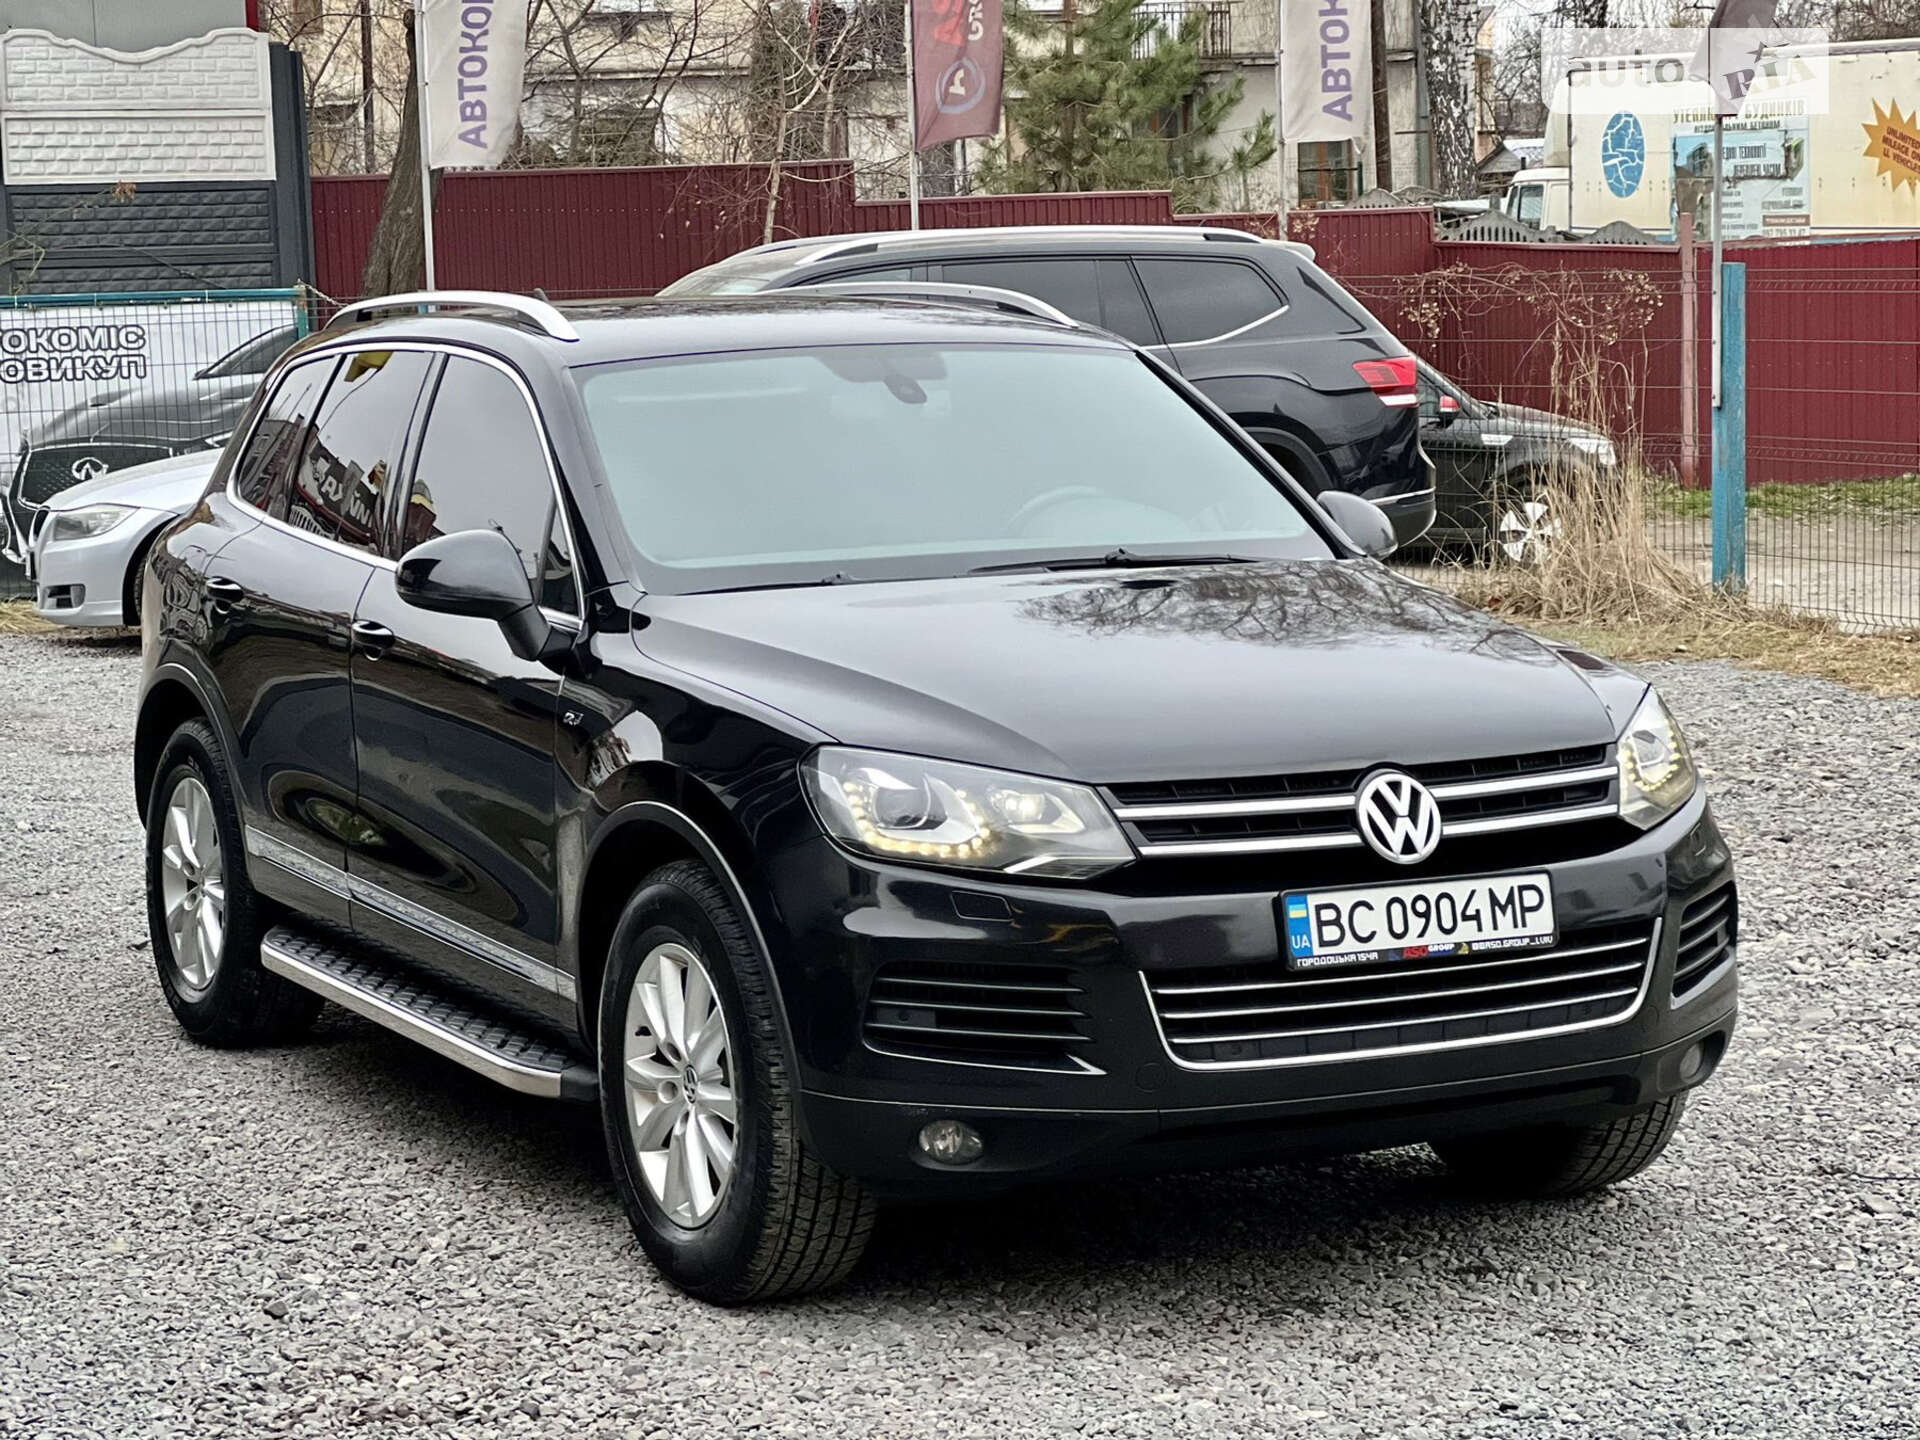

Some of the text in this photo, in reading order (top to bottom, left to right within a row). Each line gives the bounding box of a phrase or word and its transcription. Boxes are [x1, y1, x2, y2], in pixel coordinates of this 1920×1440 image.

[457, 0, 494, 149] АВТОКО
[0, 324, 146, 355] ОКОМІС
[1314, 883, 1545, 948] BC 0904 MP
[1291, 933, 1311, 949] UA
[1428, 943, 1455, 952] GROUP
